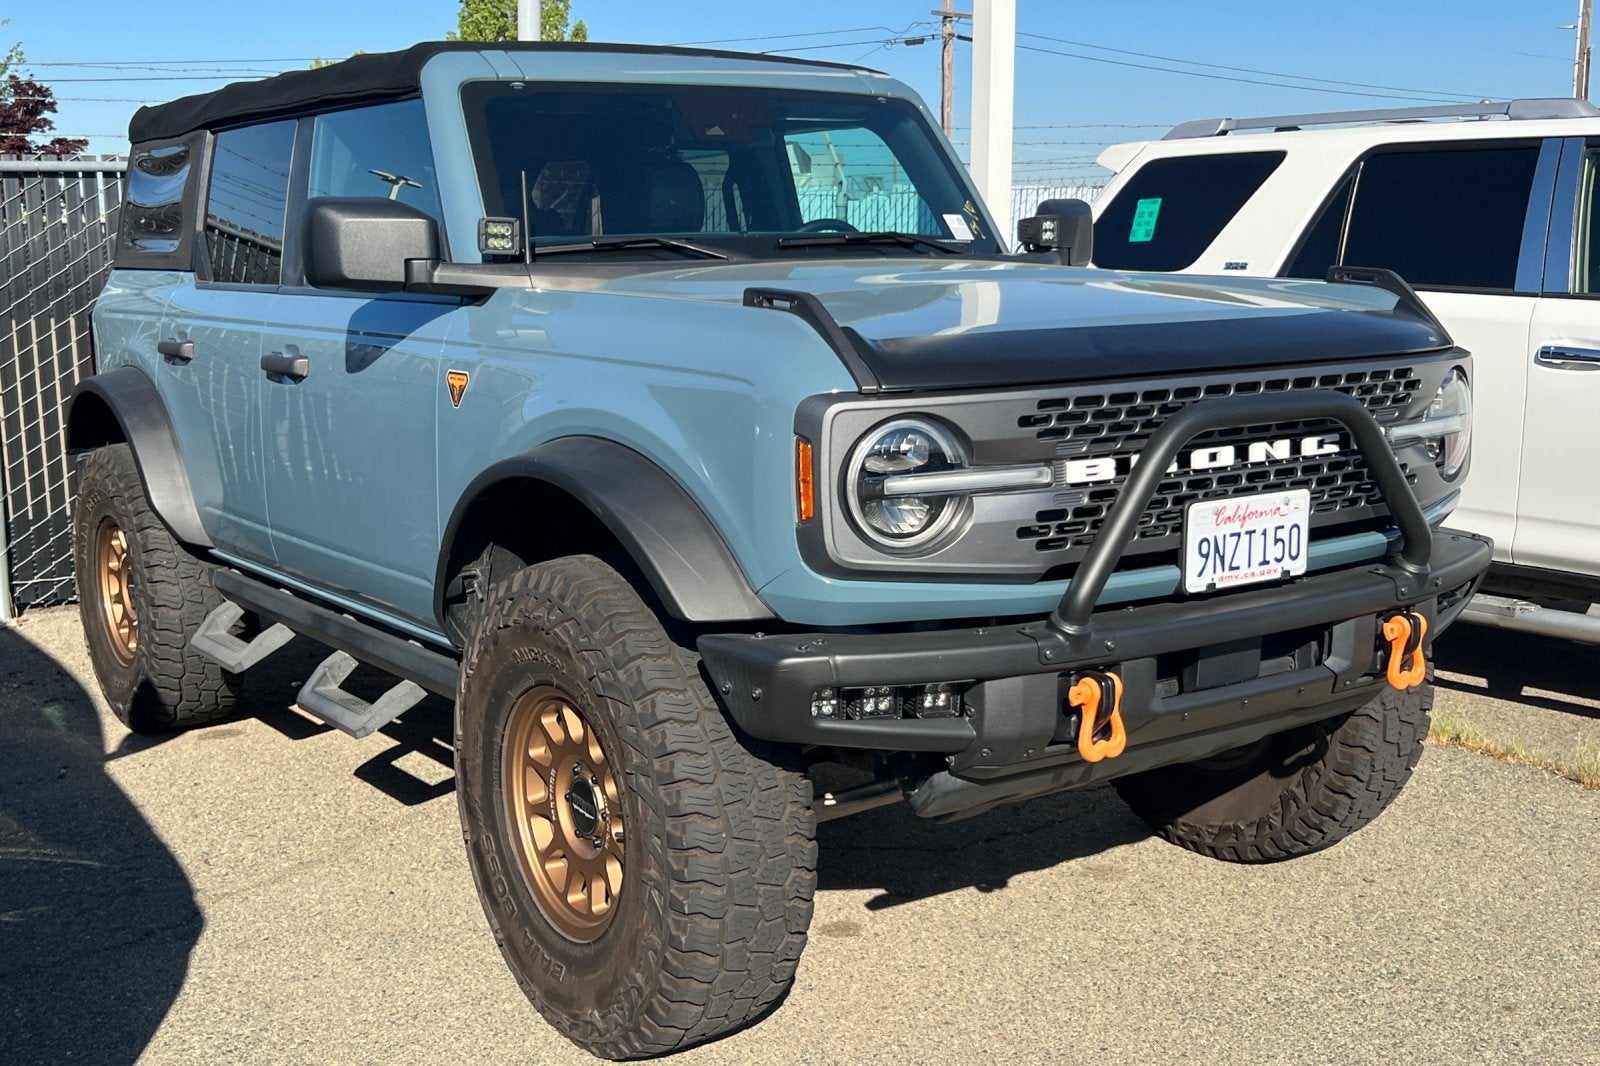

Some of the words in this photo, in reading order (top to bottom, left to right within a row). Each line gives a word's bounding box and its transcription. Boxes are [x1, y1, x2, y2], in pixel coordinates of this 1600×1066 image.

[1065, 427, 1386, 484] BONC
[1215, 503, 1288, 529] California
[1196, 522, 1301, 577] 9NZT150
[1217, 567, 1279, 583] dmv.ca.gov
[480, 832, 518, 920] BOSS
